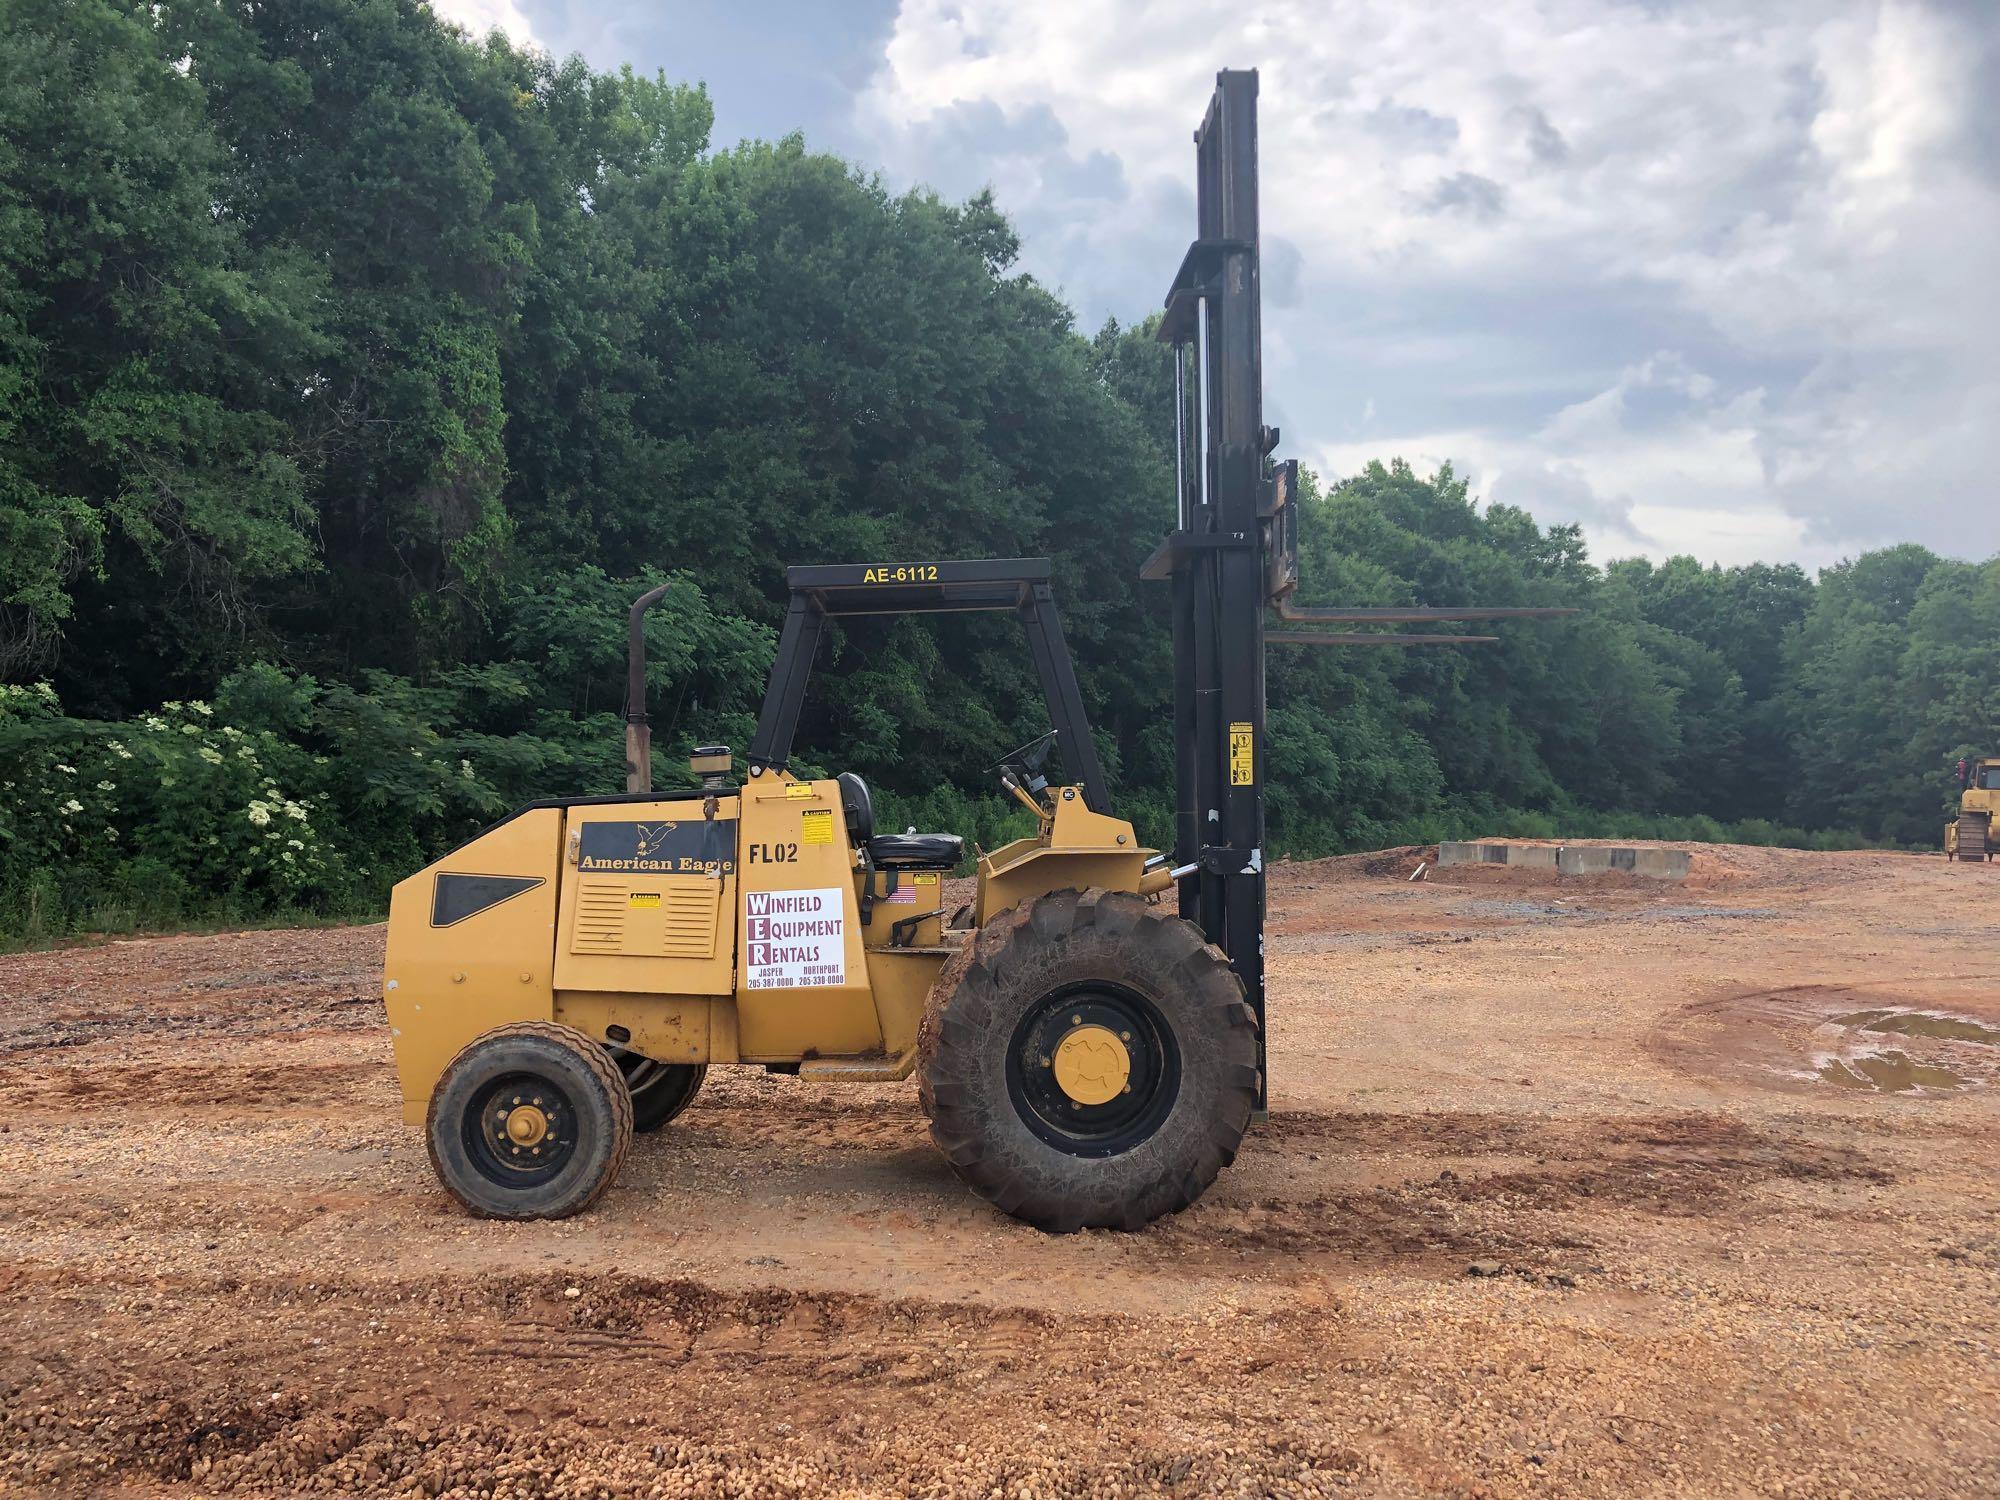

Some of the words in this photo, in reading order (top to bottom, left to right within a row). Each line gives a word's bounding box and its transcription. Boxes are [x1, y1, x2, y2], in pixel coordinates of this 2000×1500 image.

[863, 565, 938, 583] AE-6112
[580, 855, 673, 870] American
[749, 843, 798, 864] FL02
[748, 894, 822, 915] WINFIELD
[753, 919, 842, 940] EQUIPMENT
[752, 943, 820, 965] RENTALS
[759, 967, 783, 978] JASPER
[803, 964, 839, 975] NORTHPORT
